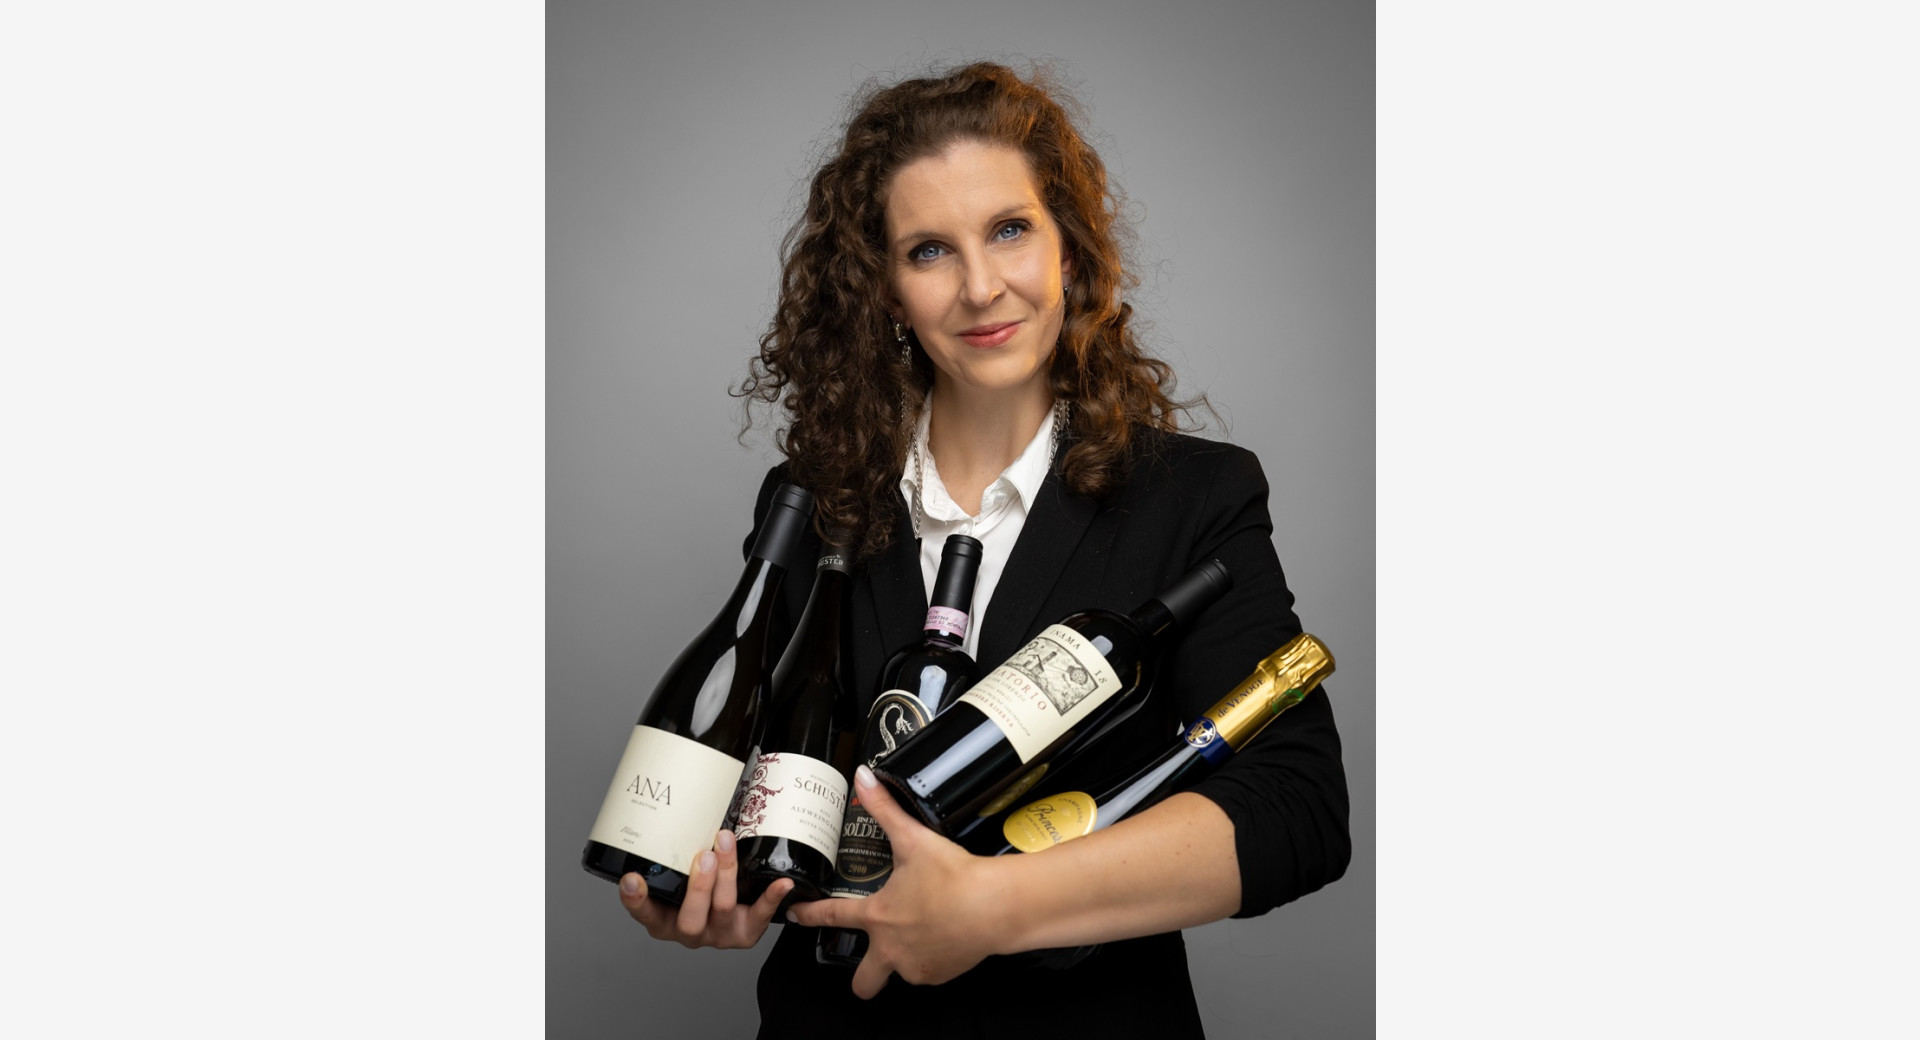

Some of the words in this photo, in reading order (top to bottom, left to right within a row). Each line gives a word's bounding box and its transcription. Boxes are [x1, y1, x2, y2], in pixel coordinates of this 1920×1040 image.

[1050, 628, 1082, 651] INAMA
[1226, 677, 1267, 709] VENOGE
[626, 774, 671, 805] ANA
